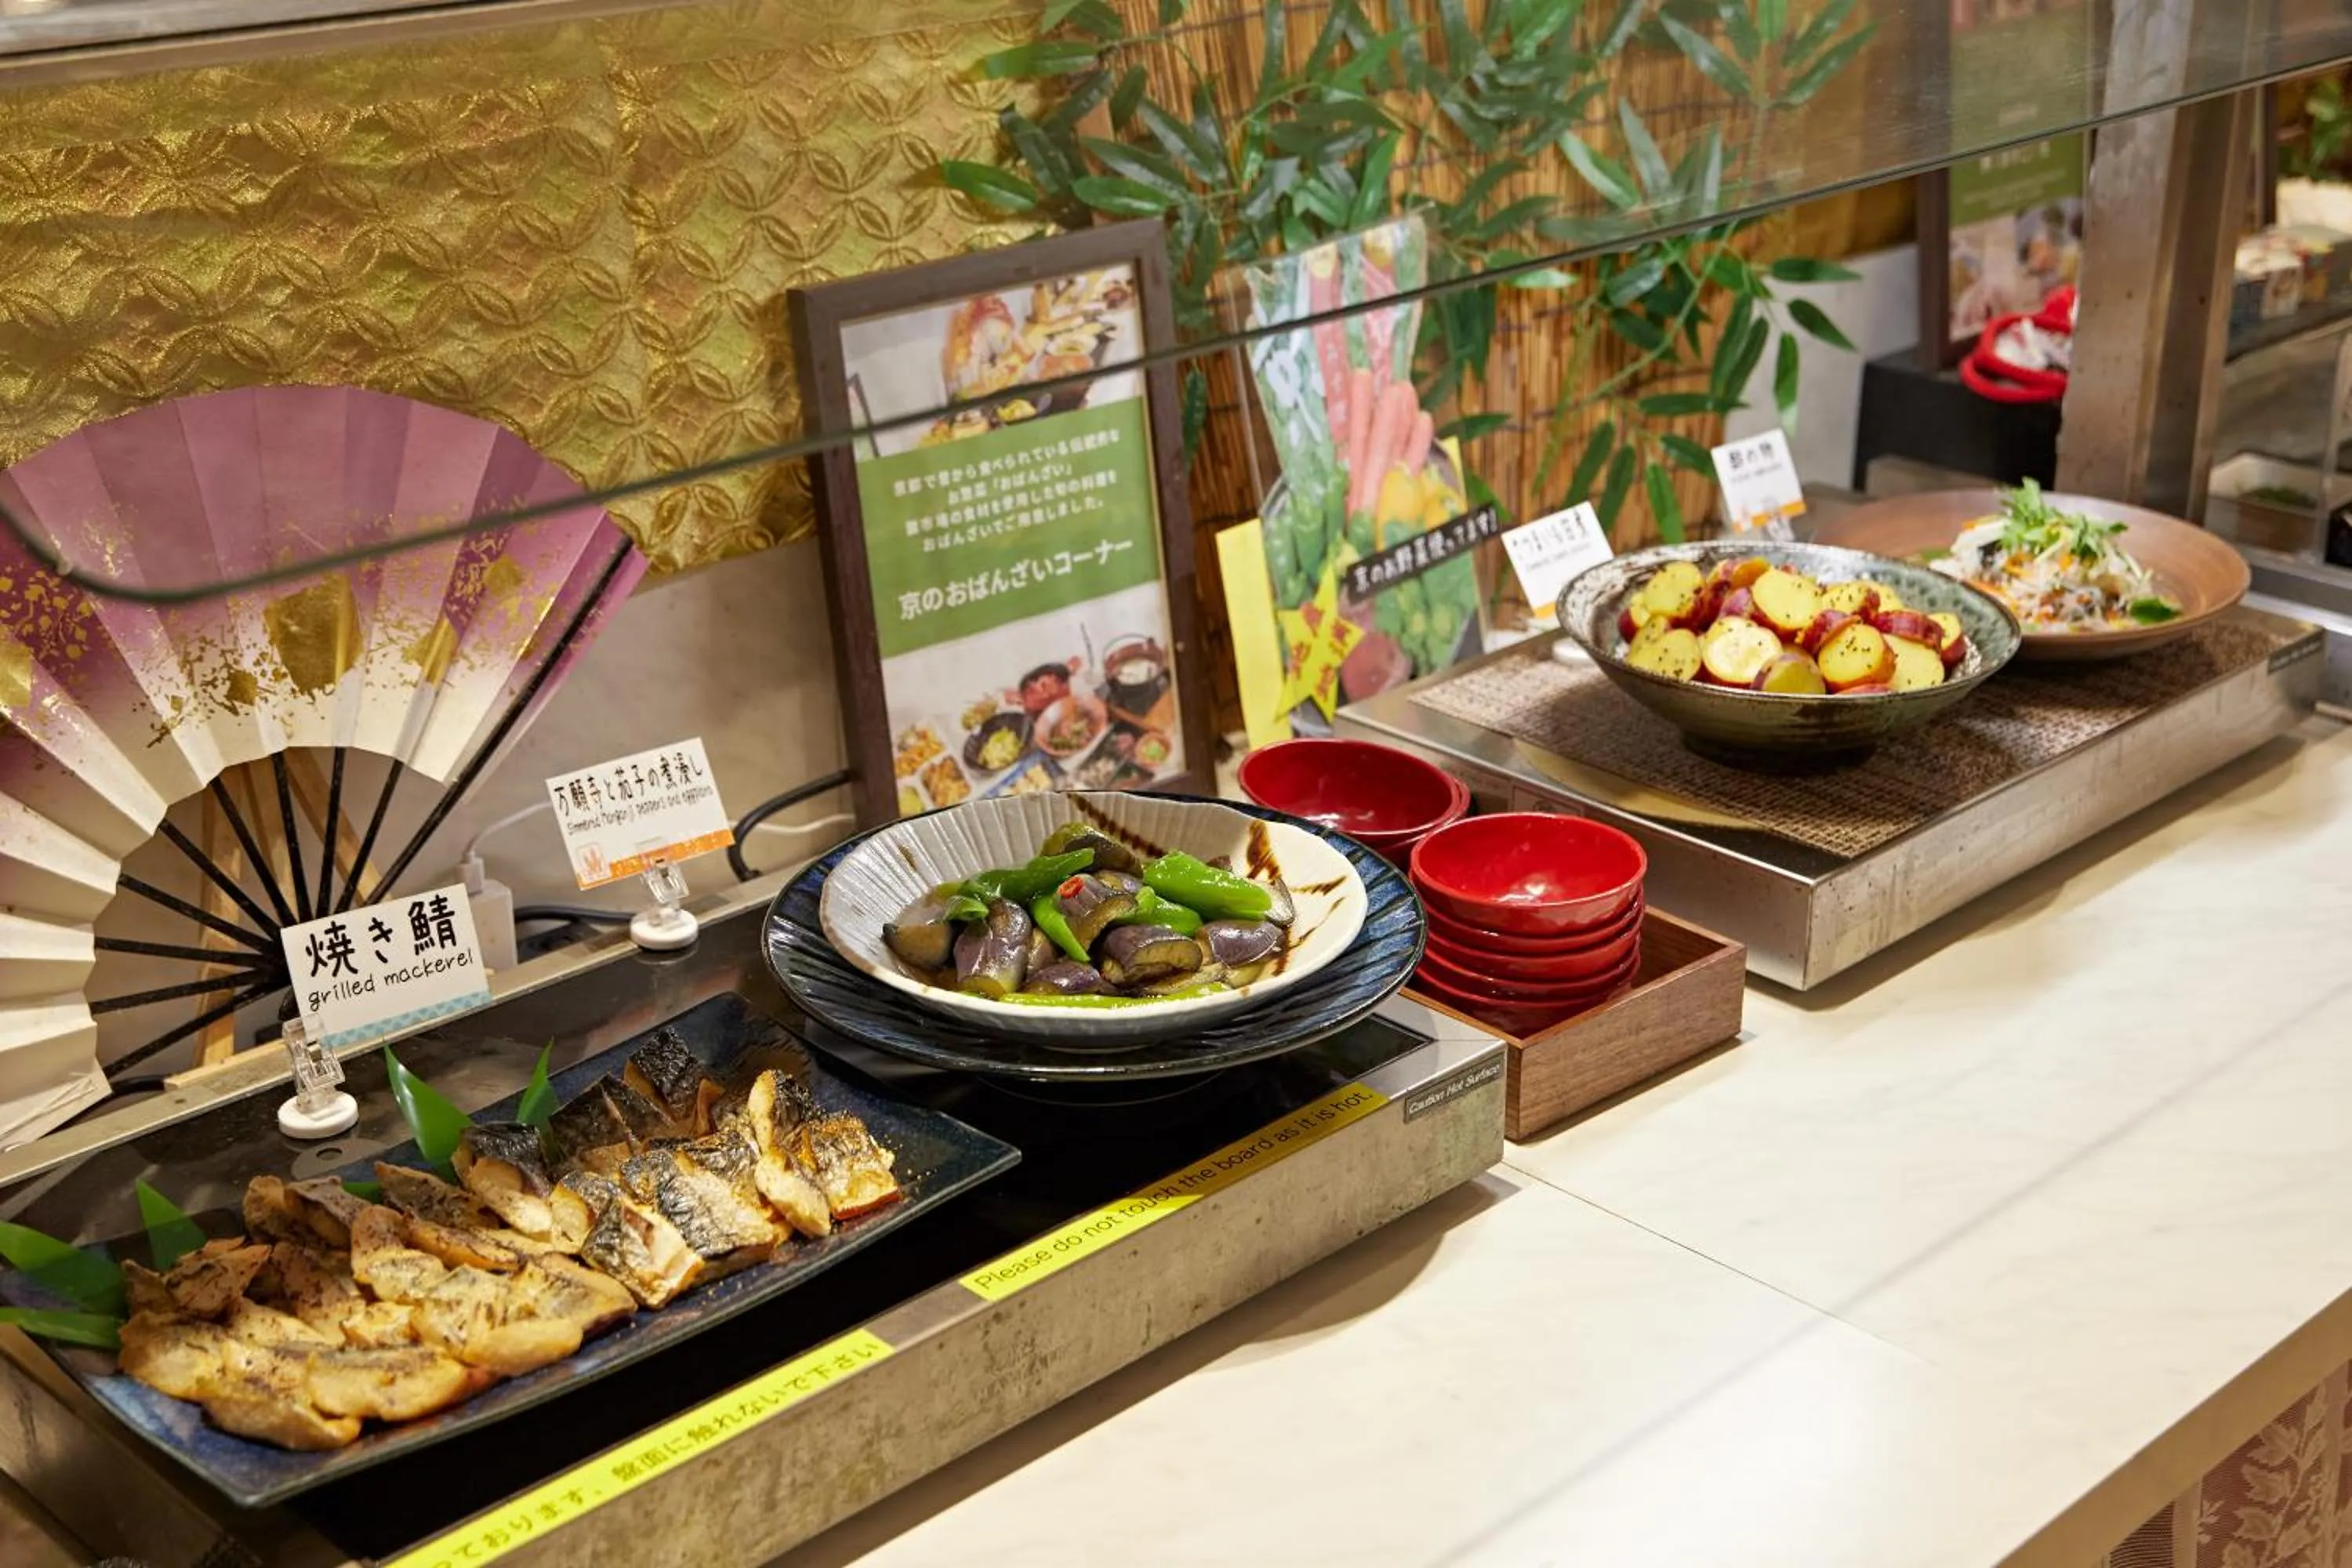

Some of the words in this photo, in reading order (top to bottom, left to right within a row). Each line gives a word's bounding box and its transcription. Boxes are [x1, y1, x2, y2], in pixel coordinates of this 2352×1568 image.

[898, 539, 1133, 620] 京のおばんざいコーナー
[554, 752, 703, 816] 万願寺と茄子の煮浸し
[305, 894, 457, 978] 焼き鯖
[308, 973, 376, 1012] grilled
[383, 948, 474, 985] mackerel
[1446, 1080, 1464, 1097] Hot
[974, 1250, 1053, 1290] Please
[1053, 1234, 1083, 1253] do
[1083, 1216, 1121, 1238] not
[1119, 1184, 1181, 1218] touch
[1178, 1167, 1216, 1189] the
[1212, 1138, 1275, 1171] board
[1273, 1128, 1301, 1143] as
[1294, 1117, 1318, 1131] it
[1312, 1107, 1335, 1121] is
[1329, 1091, 1374, 1112] hot.
